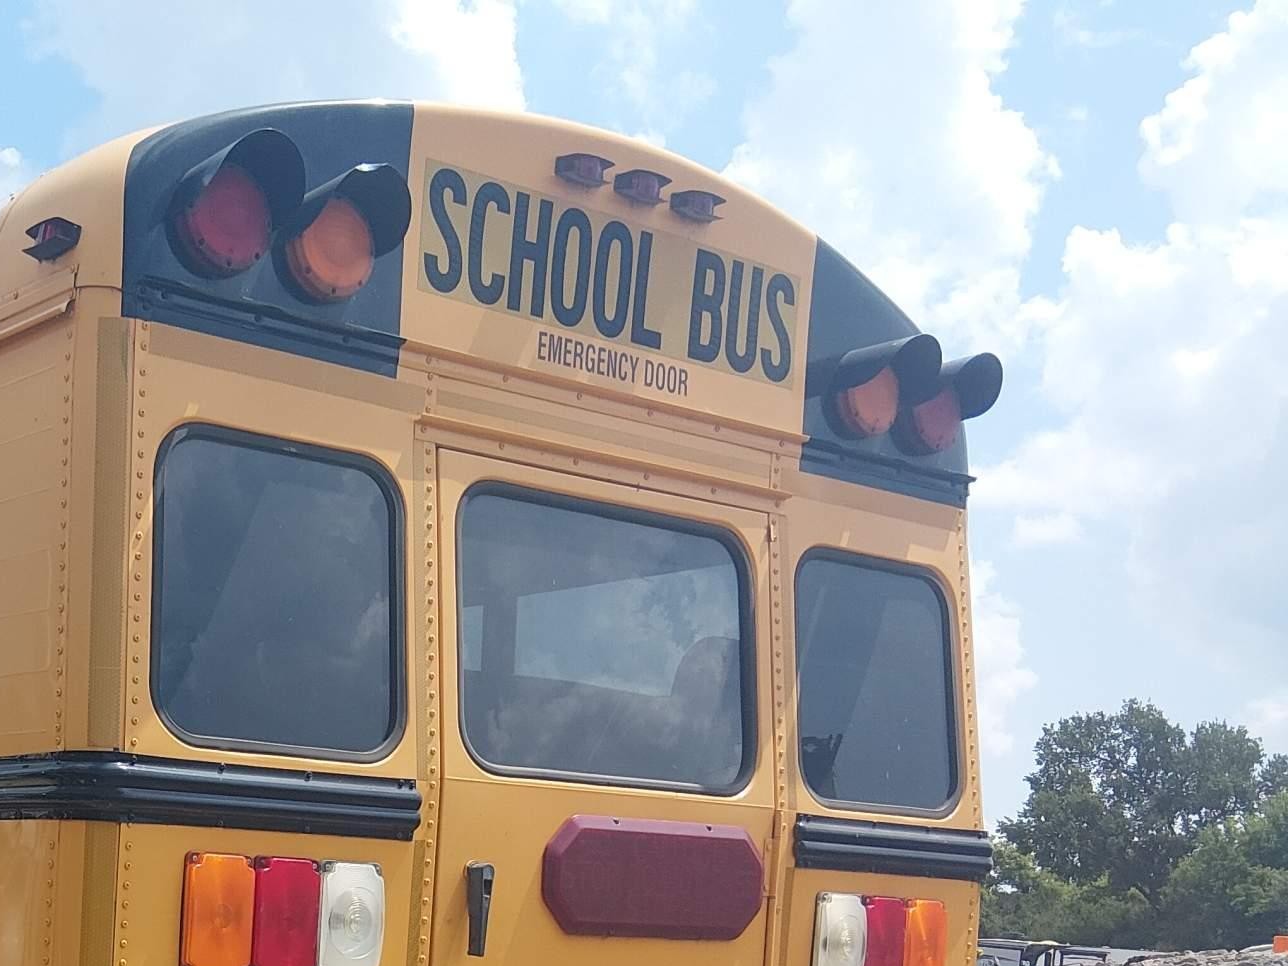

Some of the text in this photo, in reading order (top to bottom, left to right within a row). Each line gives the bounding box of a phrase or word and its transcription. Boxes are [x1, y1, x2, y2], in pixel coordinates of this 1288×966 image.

[423, 168, 795, 384] SCHOOL BUS
[537, 331, 689, 398] EMERGENCY DOOR
